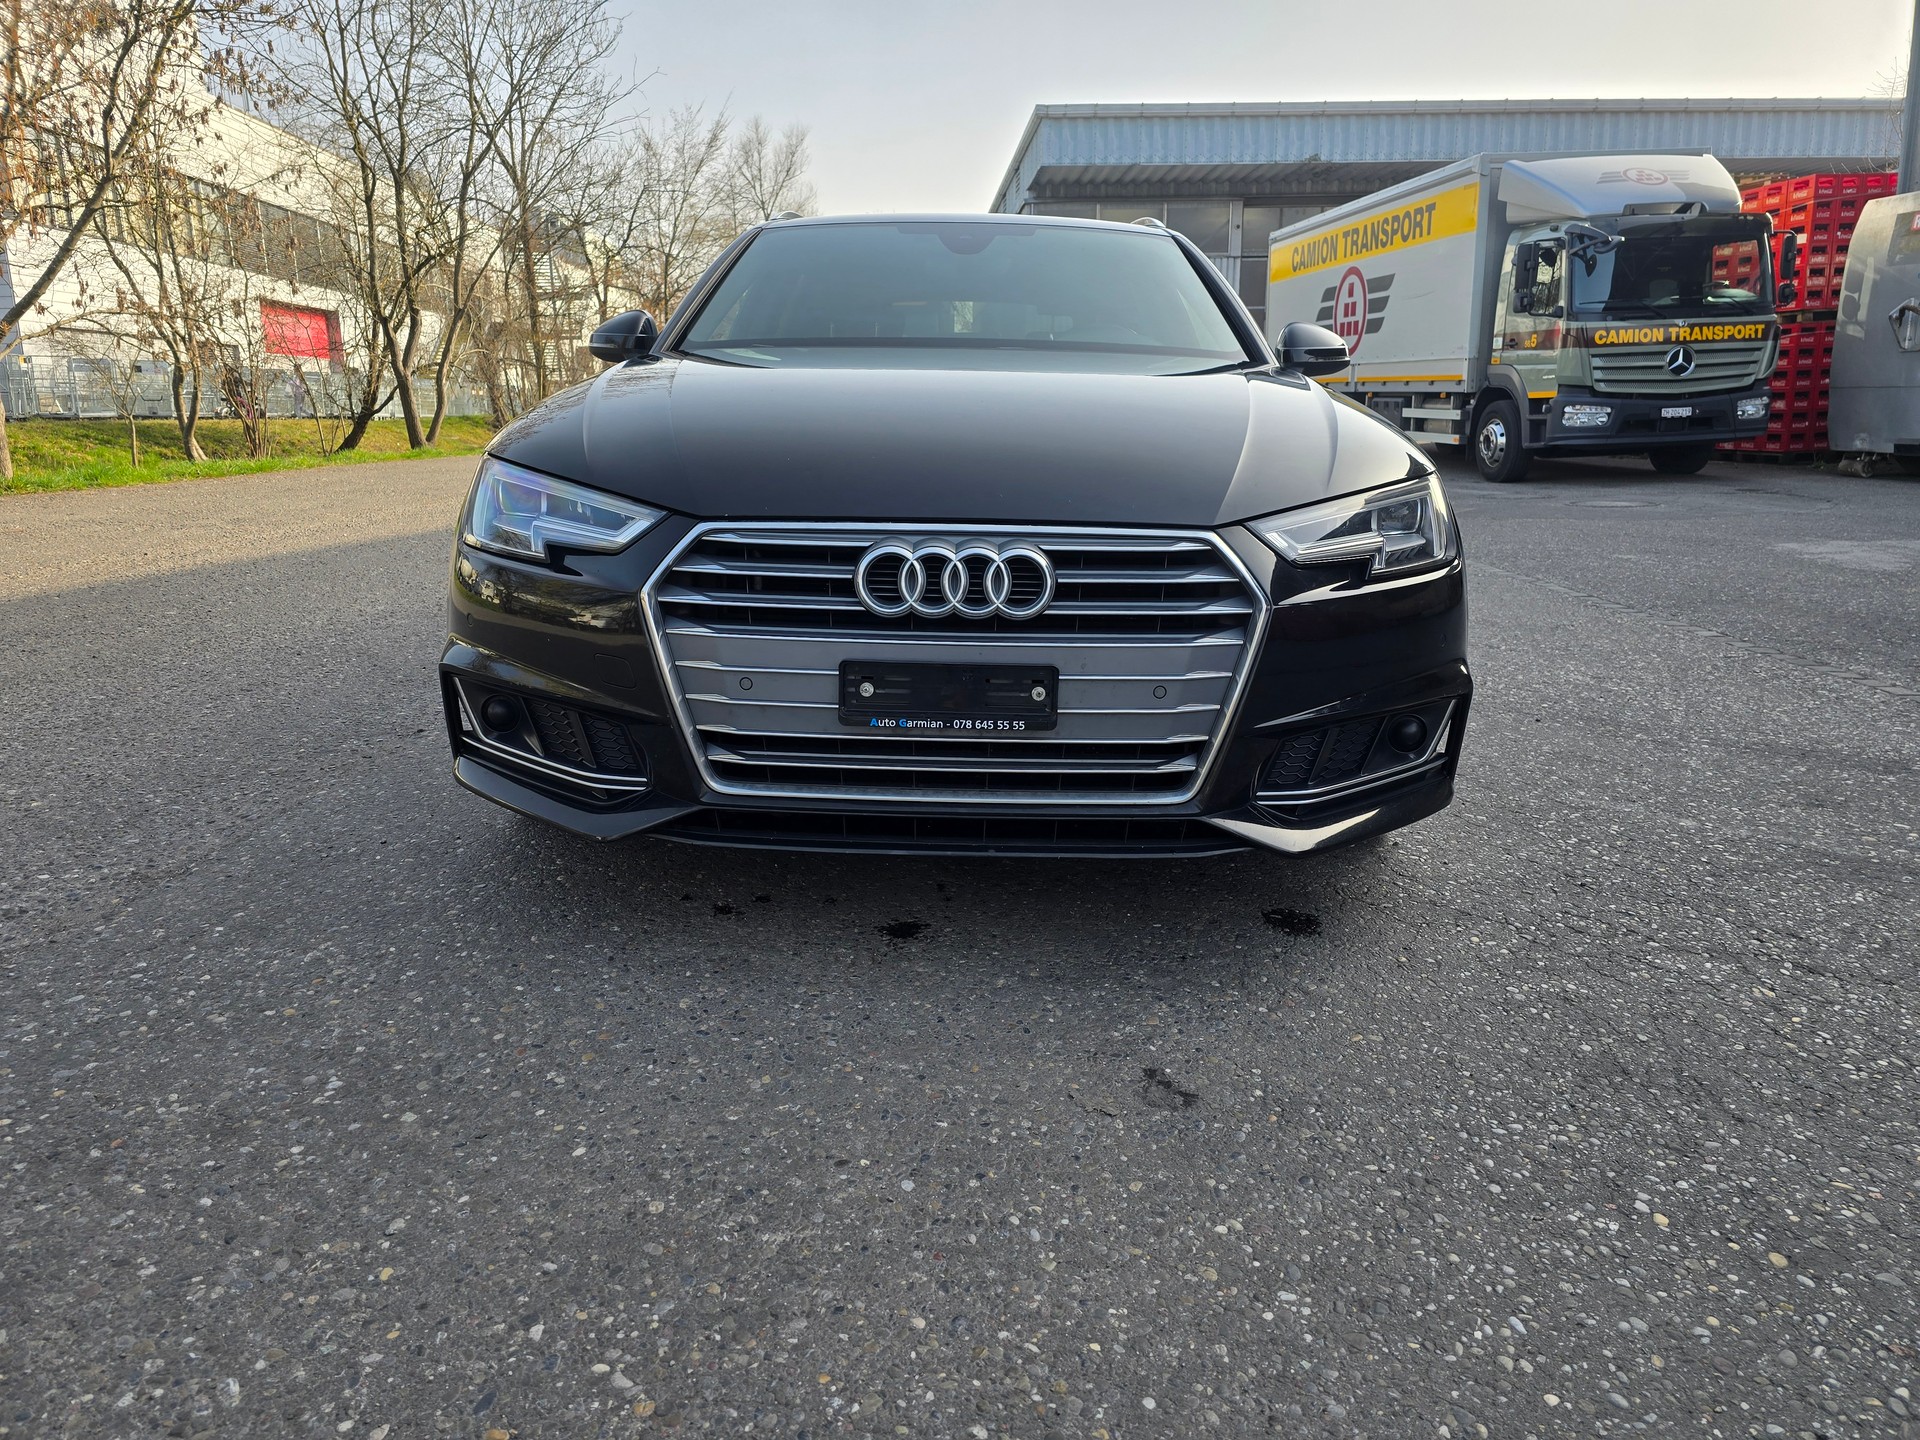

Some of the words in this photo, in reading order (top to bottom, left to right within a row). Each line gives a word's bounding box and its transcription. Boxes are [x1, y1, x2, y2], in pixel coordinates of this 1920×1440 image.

[1292, 234, 1338, 272] CAMION
[1342, 202, 1436, 258] TRANSPORT
[1595, 328, 1664, 344] CAMION
[1669, 324, 1765, 342] TRANSPORT
[870, 718, 896, 727] Auto
[899, 718, 943, 728] Garmian
[953, 720, 973, 729] 078
[975, 720, 994, 729] 645
[997, 720, 1010, 730] 55
[1012, 721, 1025, 730] 55
